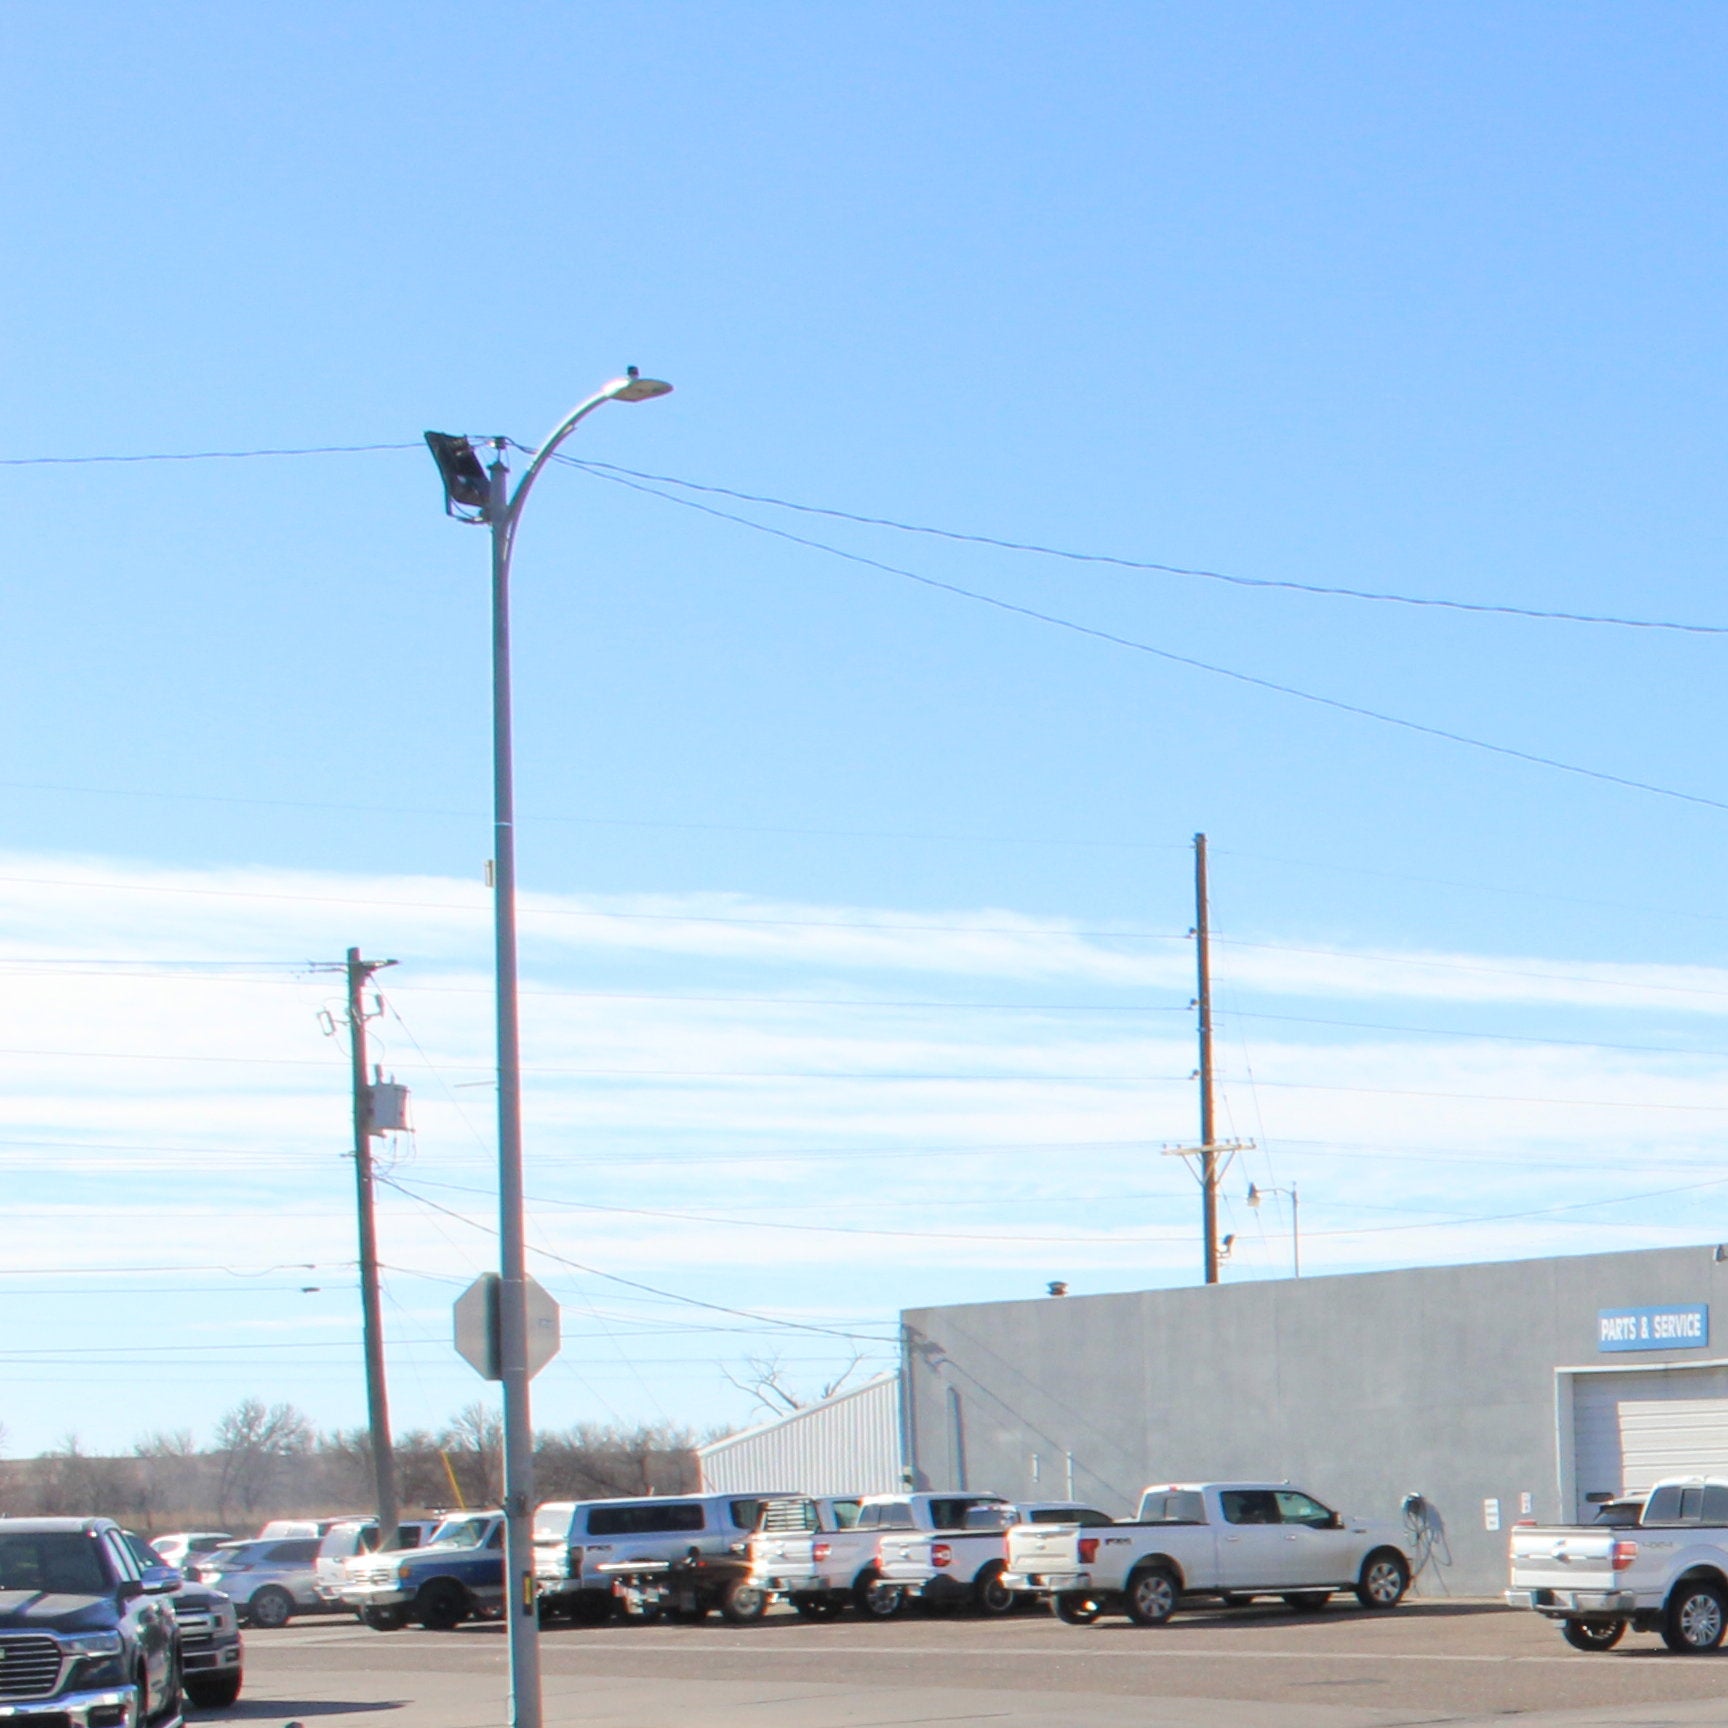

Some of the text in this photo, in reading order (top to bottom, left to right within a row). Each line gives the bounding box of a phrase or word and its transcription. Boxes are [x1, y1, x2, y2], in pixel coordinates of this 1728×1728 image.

[1601, 1313, 1701, 1341] PARTS & SERVICE
